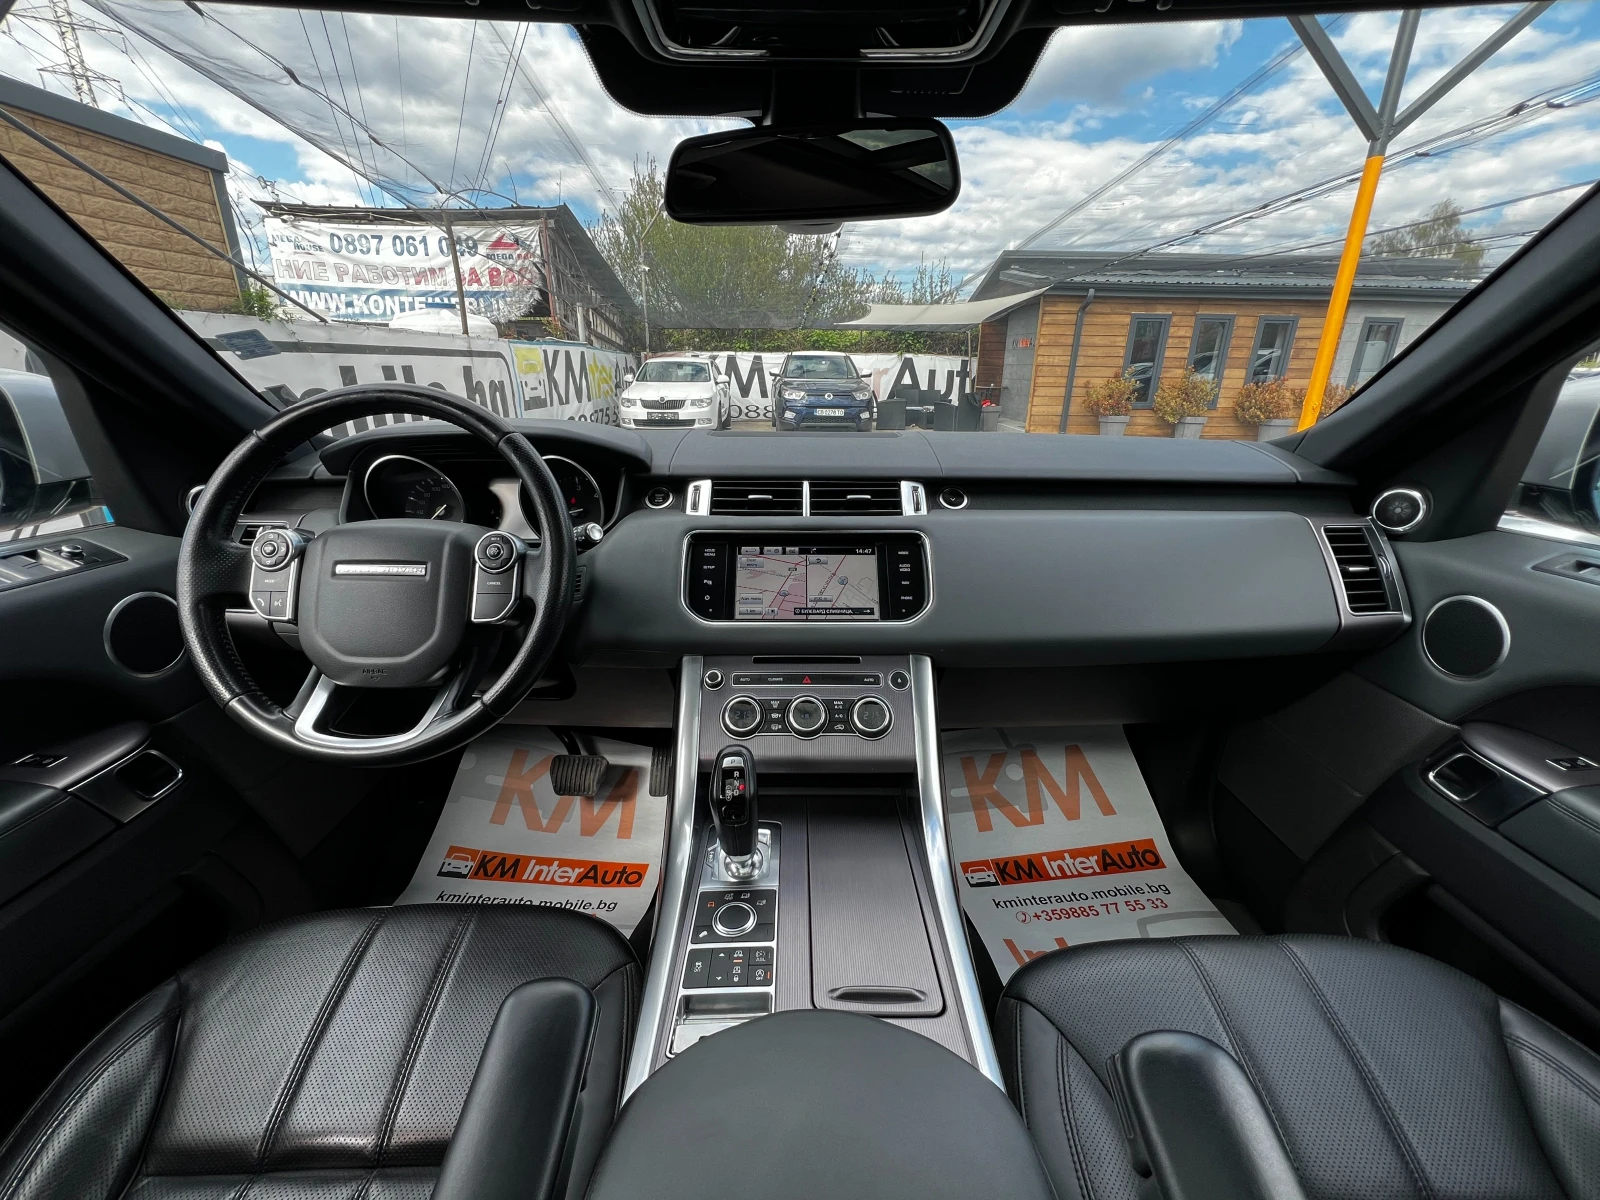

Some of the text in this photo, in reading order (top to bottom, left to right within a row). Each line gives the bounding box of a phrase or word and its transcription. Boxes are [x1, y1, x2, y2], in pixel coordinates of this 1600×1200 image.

[329, 233, 384, 256] 0897
[392, 235, 430, 257] 061
[276, 258, 330, 282] НИЕ
[334, 262, 448, 287] РАБОТИМ
[542, 349, 592, 408] KM
[489, 748, 639, 839] KM
[960, 744, 1117, 833] KM
[474, 854, 643, 885] KM InterAuto
[998, 847, 1161, 883] KM InterAuto
[436, 890, 618, 912] kminterautomobile.bg
[992, 882, 1171, 910] kminterauto.mobile.bg
[1101, 902, 1121, 915] 77
[1128, 899, 1147, 913] 55
[1149, 897, 1170, 910] 33
